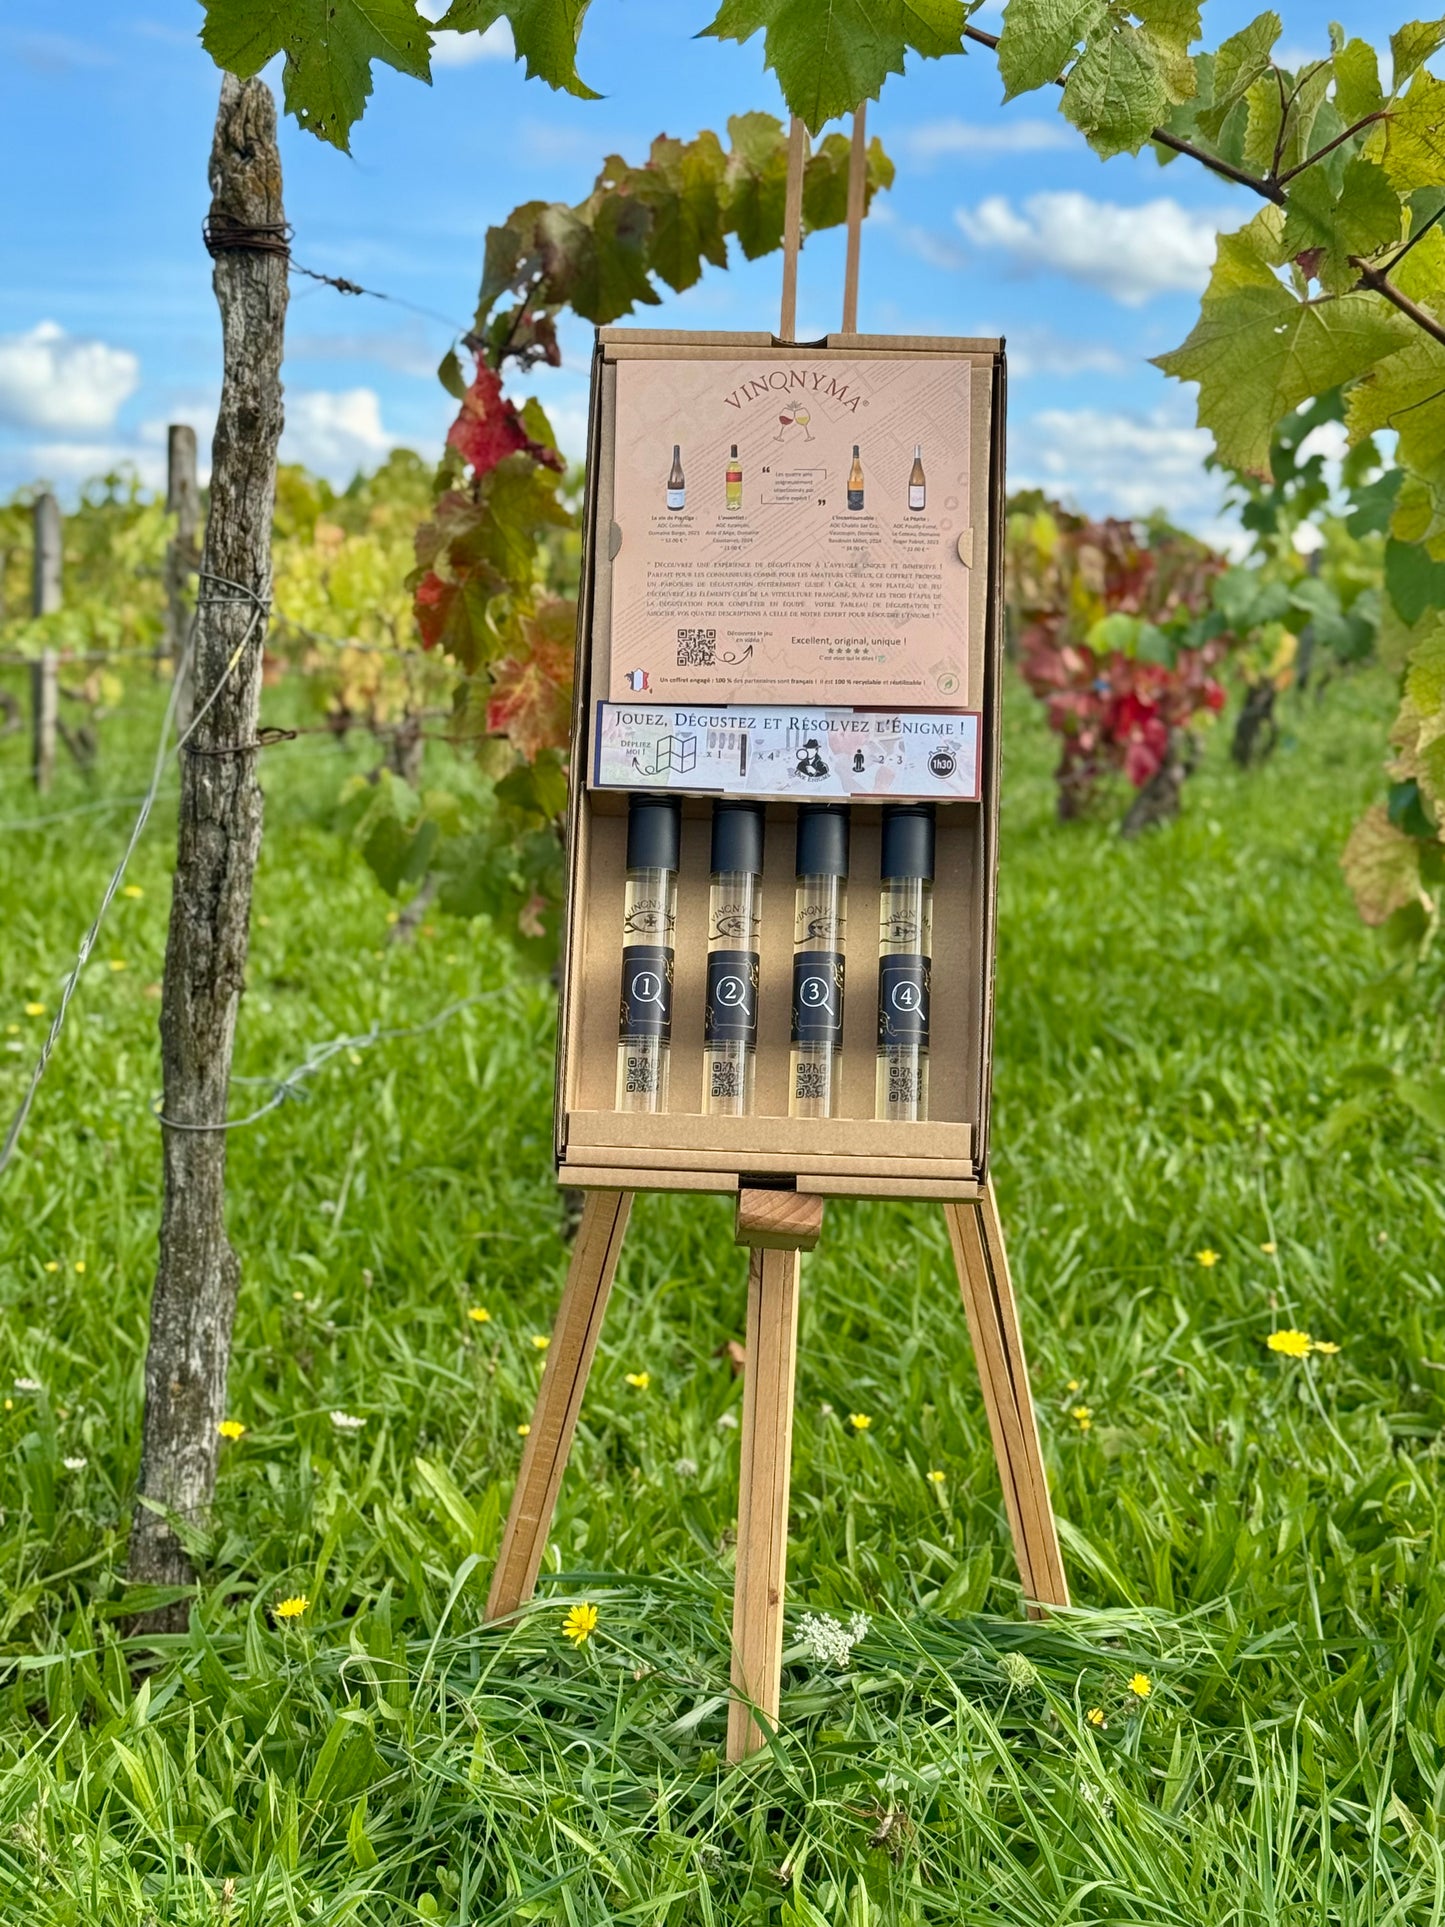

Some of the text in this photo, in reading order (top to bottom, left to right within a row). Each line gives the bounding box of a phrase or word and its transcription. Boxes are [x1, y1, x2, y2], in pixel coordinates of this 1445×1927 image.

[791, 637, 832, 646] Excellent,
[834, 637, 869, 646] original,
[871, 638, 901, 647] unique
[615, 711, 668, 727] JOUEZ,
[675, 712, 757, 729] DÉGUSTEZ
[764, 718, 782, 729] ET
[789, 717, 870, 733] RÉSOLVEZ
[877, 717, 954, 735] L'ÉNIGME
[932, 759, 952, 770] 1h30
[642, 978, 651, 995] 1
[725, 982, 737, 999] 2
[808, 982, 820, 1000] 3
[900, 987, 912, 1005] 4
